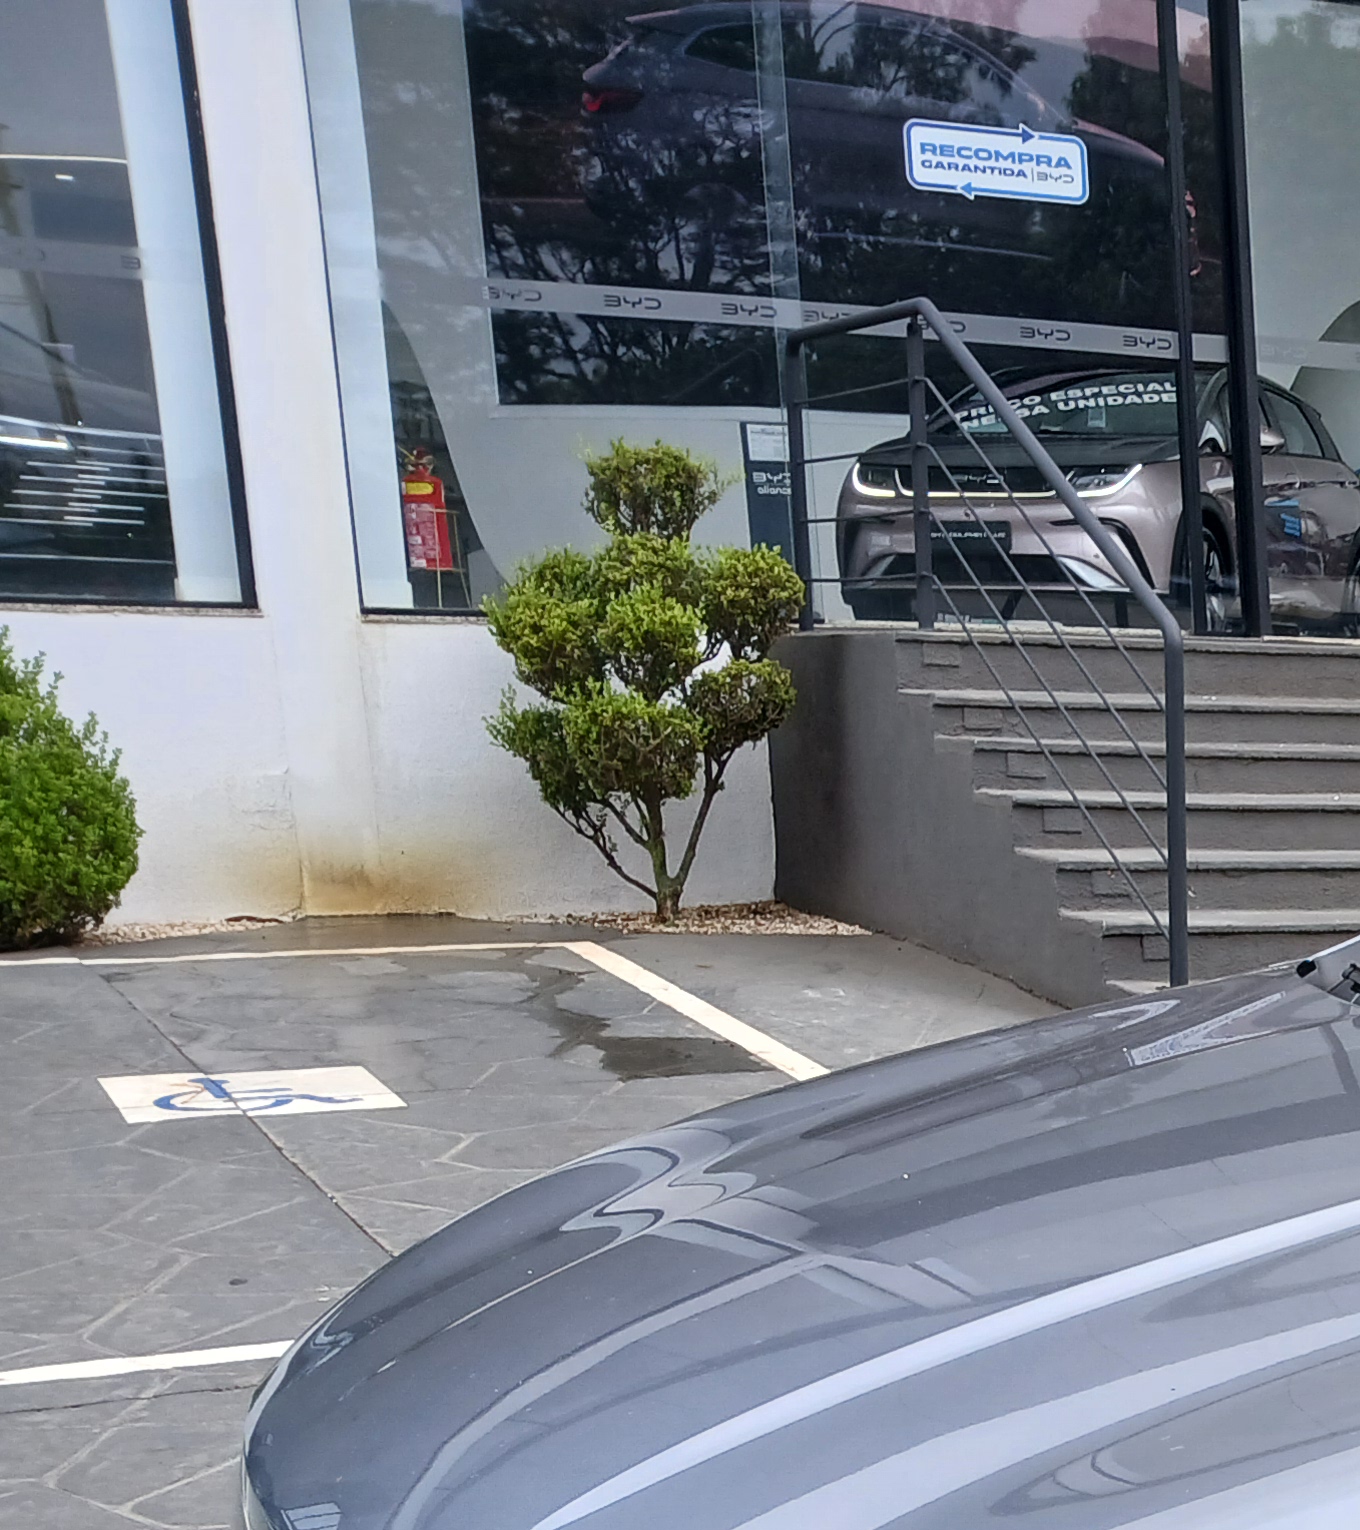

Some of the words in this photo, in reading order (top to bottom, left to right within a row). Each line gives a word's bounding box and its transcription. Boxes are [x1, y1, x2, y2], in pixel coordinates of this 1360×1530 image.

[920, 142, 1073, 170] RECOMPRA
[921, 159, 1028, 179] GARANTIDA
[1036, 171, 1075, 184] BYD
[604, 294, 661, 311] BYD
[721, 302, 777, 318] BYD
[1019, 326, 1071, 341] BYD
[1122, 334, 1172, 350] BYD
[1050, 381, 1176, 403] ESPECIAL
[1056, 392, 1176, 412] UNIDADE
